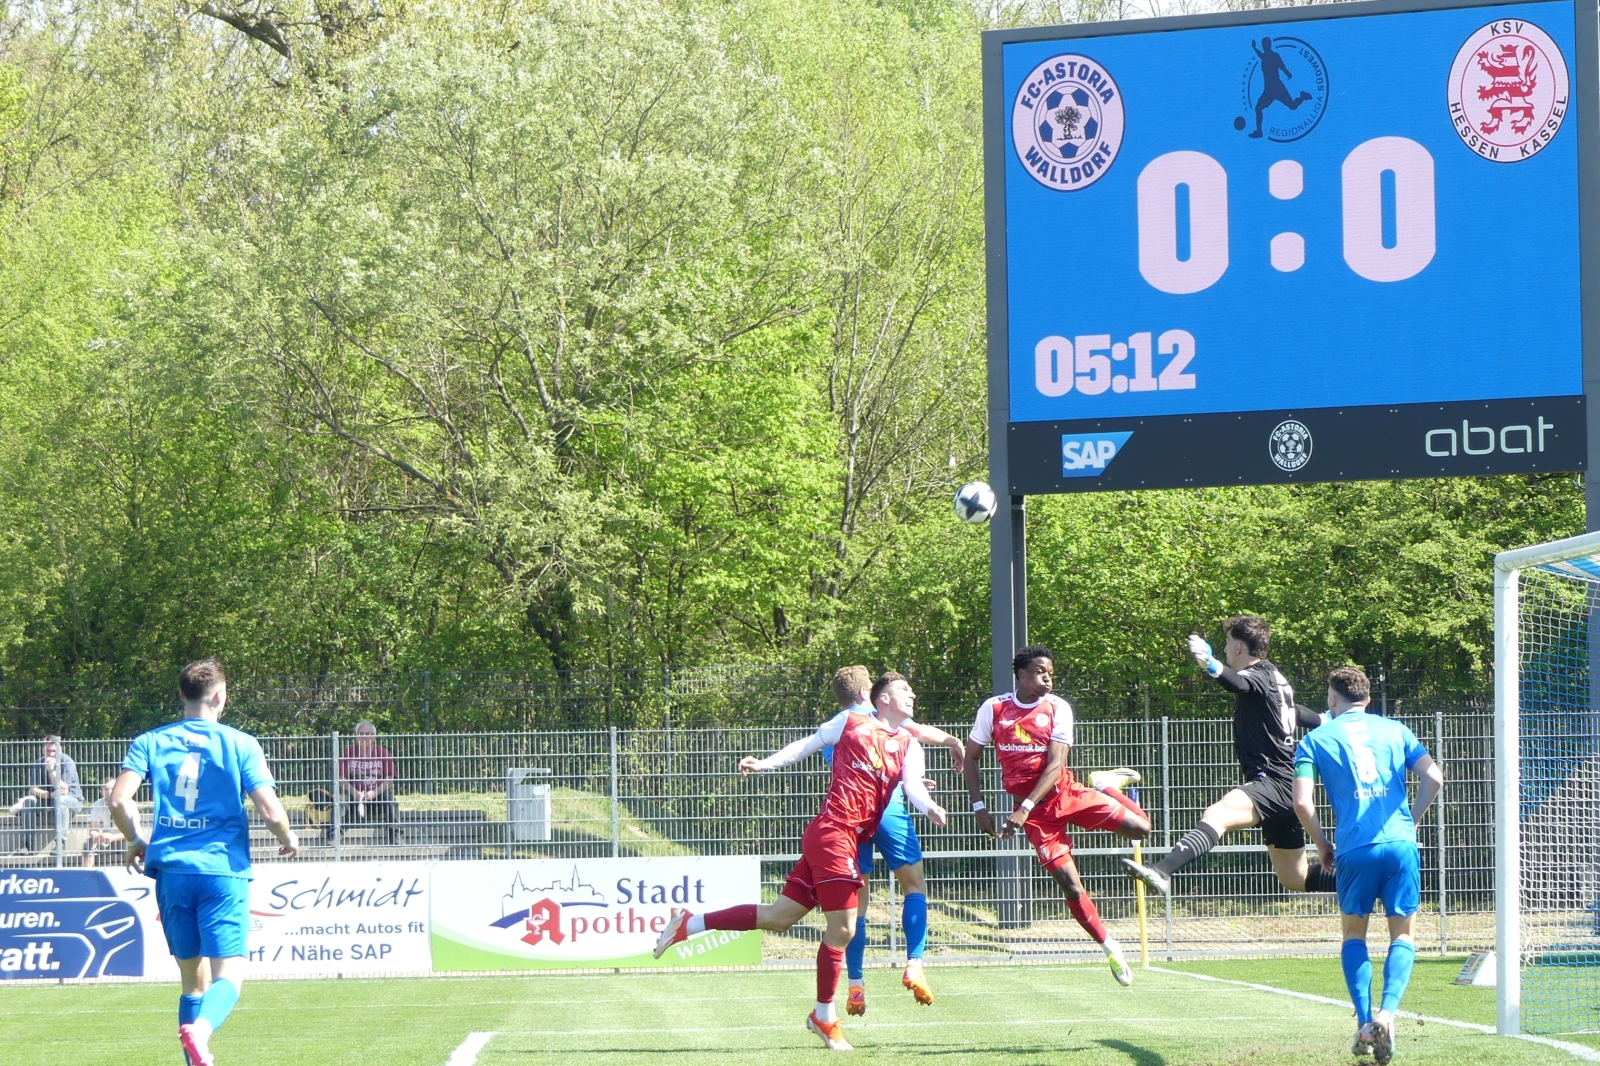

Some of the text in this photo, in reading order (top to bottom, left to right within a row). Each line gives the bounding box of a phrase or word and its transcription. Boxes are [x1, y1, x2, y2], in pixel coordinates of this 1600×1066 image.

[1490, 21, 1524, 36] KSV
[1020, 61, 1116, 110] FC-ASTORIA
[1269, 95, 1323, 137] REGIONALLIGA
[1450, 95, 1567, 159] HESSEN KASSEL
[1024, 140, 1113, 185] WALLDORF
[1137, 150, 1229, 294] 0
[1341, 136, 1436, 282] 0
[1034, 328, 1197, 397] 05:12
[1425, 415, 1554, 457] abat
[1063, 440, 1116, 470] SAP
[1274, 453, 1308, 469] WALLDORF
[175, 751, 202, 812] 4
[158, 815, 210, 829] abat
[269, 876, 424, 910] Schmidt
[616, 875, 705, 904] Stadt
[284, 921, 426, 936] ...macht Autos fit
[676, 930, 749, 960] Walldo
[249, 945, 265, 962] rf
[291, 944, 344, 961] Nähe
[350, 943, 392, 960] SAP
